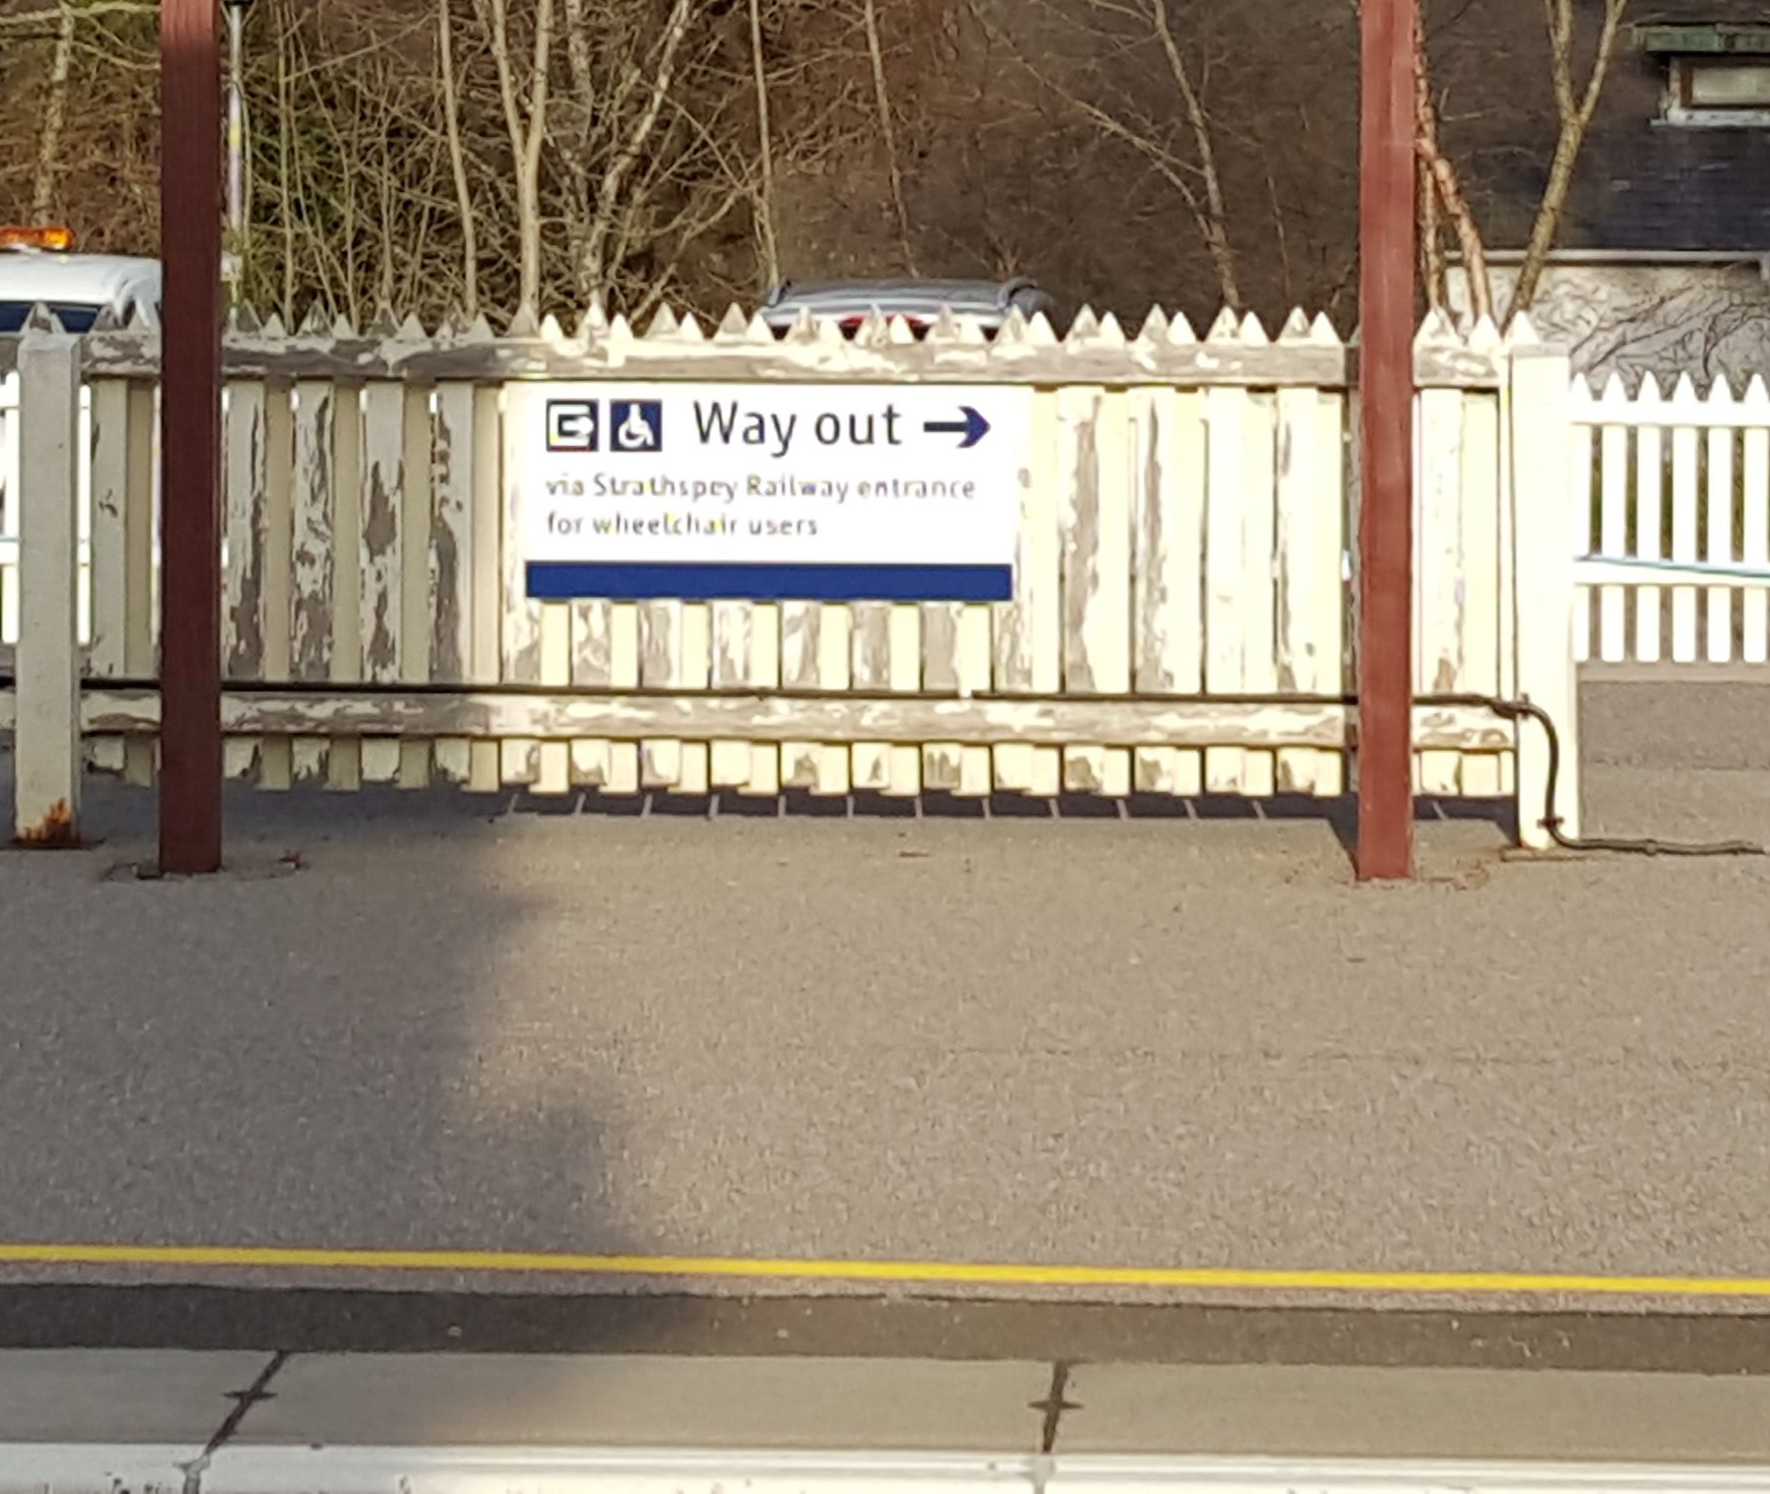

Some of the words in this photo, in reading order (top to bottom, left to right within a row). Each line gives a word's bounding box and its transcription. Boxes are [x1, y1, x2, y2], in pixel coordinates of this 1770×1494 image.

[693, 400, 796, 457] Way
[815, 404, 902, 445] out
[546, 474, 585, 496] via
[593, 473, 736, 502] Strathspey
[747, 475, 848, 503] Railway
[858, 478, 976, 499] entrance
[547, 511, 582, 535] for
[592, 512, 737, 536] wheelchair
[748, 519, 818, 536] users
